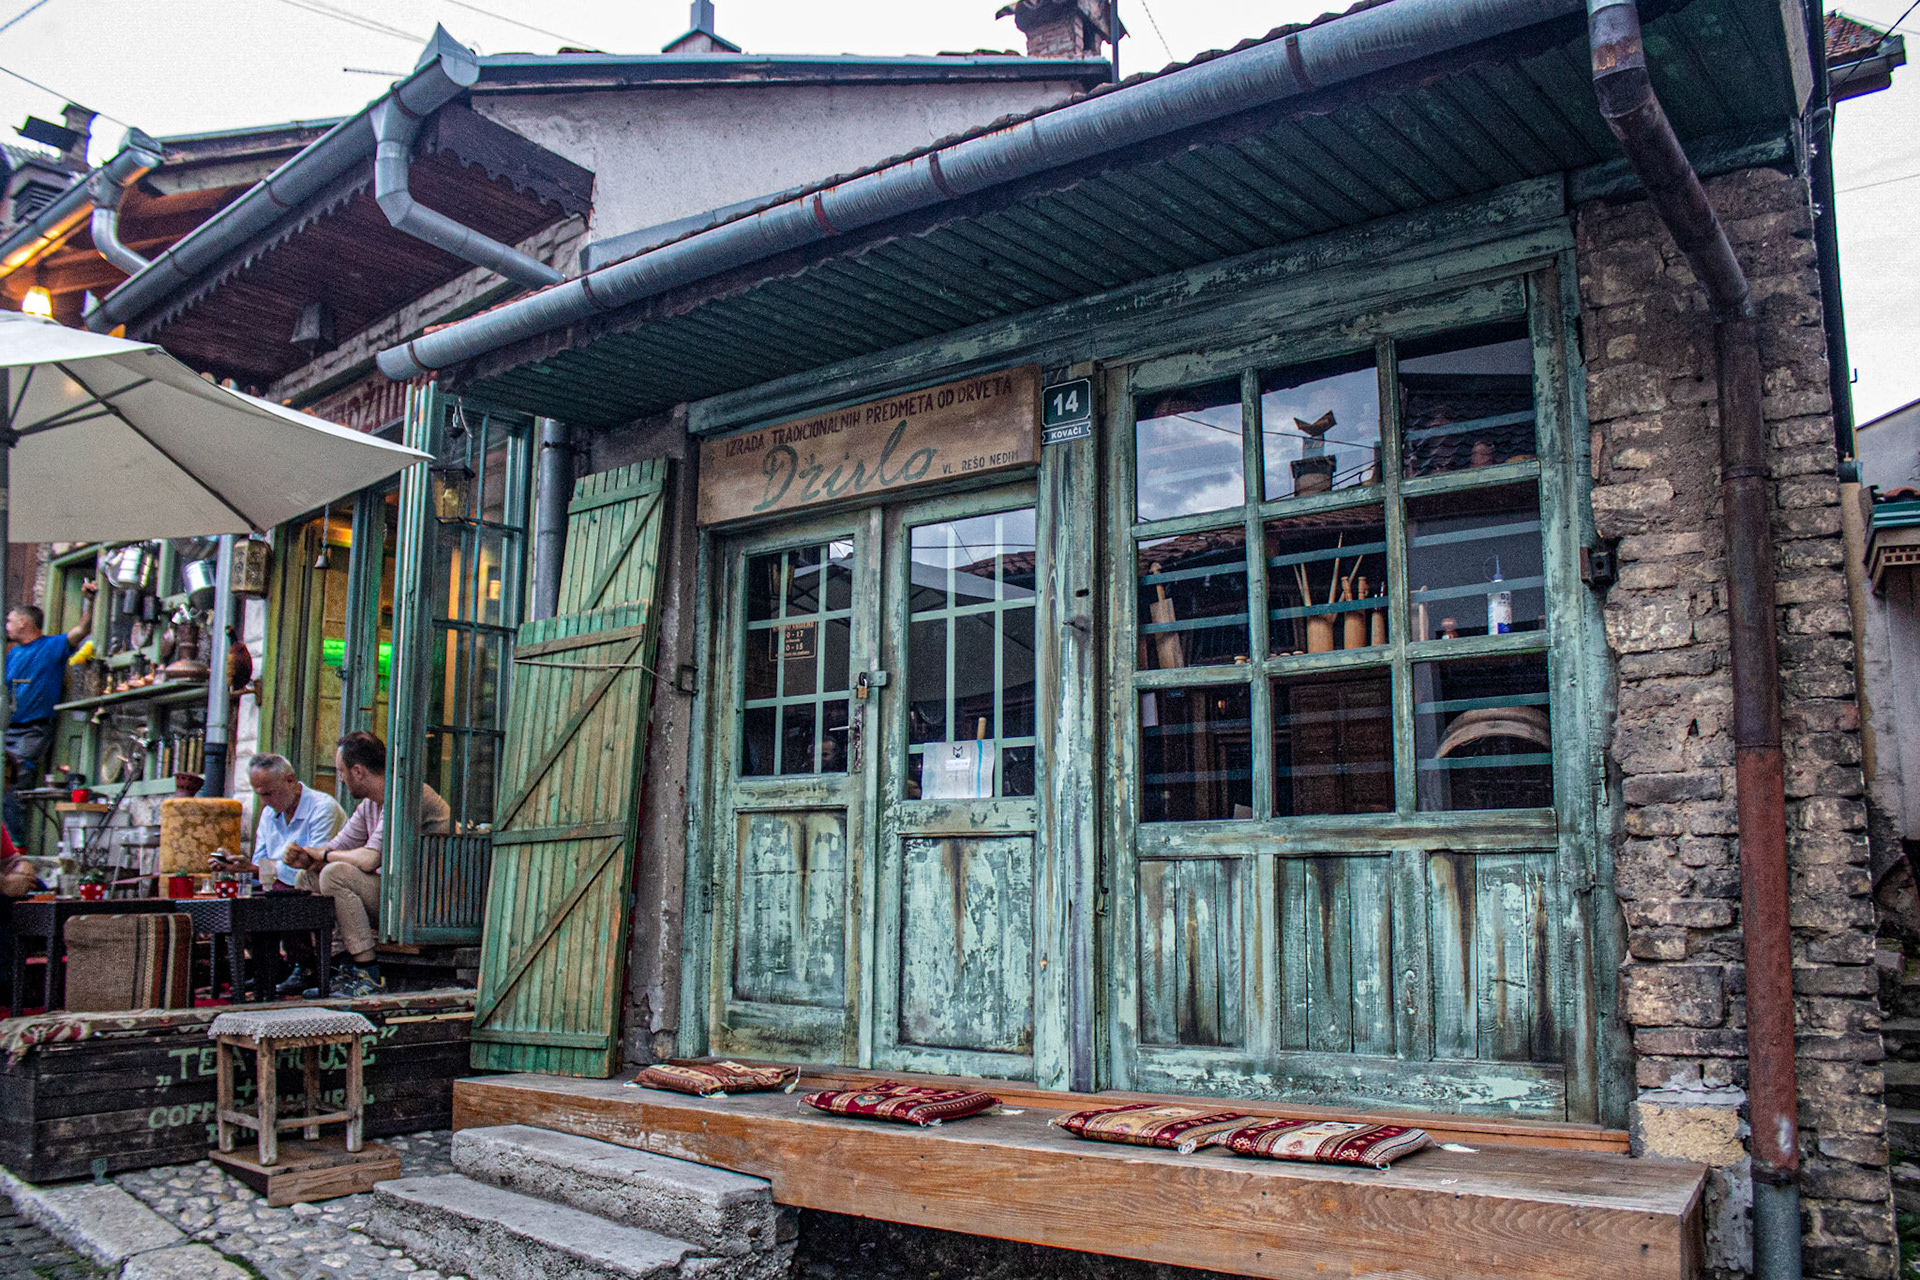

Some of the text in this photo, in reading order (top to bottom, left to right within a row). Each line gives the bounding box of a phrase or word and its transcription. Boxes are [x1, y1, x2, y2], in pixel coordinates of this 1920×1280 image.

[726, 374, 1013, 457] IZRADA TRADICIONALNIH PREDMETA OD DRVETA
[1053, 389, 1080, 416] 14
[1051, 427, 1082, 440] KOVAČI
[961, 455, 985, 472] REŠO
[989, 450, 1019, 466] NEDIM
[148, 1098, 246, 1129] COFF
